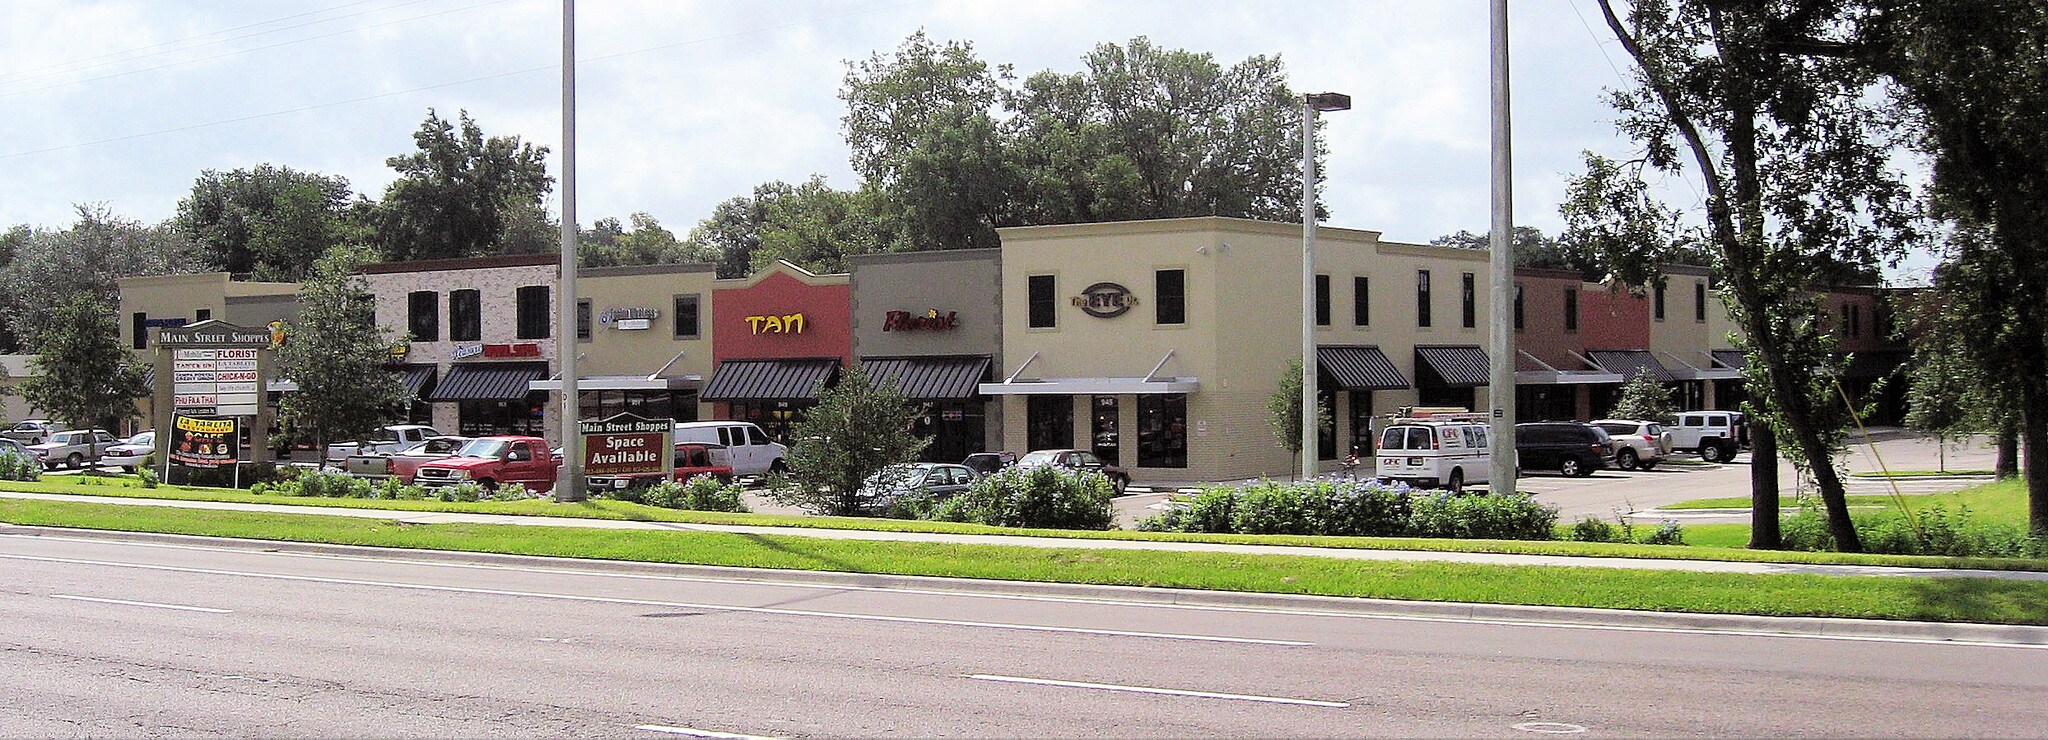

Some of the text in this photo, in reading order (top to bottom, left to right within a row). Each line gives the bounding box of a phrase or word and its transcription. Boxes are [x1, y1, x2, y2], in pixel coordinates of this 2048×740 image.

[744, 313, 804, 335] TAN
[160, 331, 270, 343] MAIN STREET SHOPPES
[217, 350, 257, 359] FLORIST
[582, 421, 668, 432] Main Street Shoppes
[606, 436, 645, 450] Space
[591, 450, 657, 464] Available
